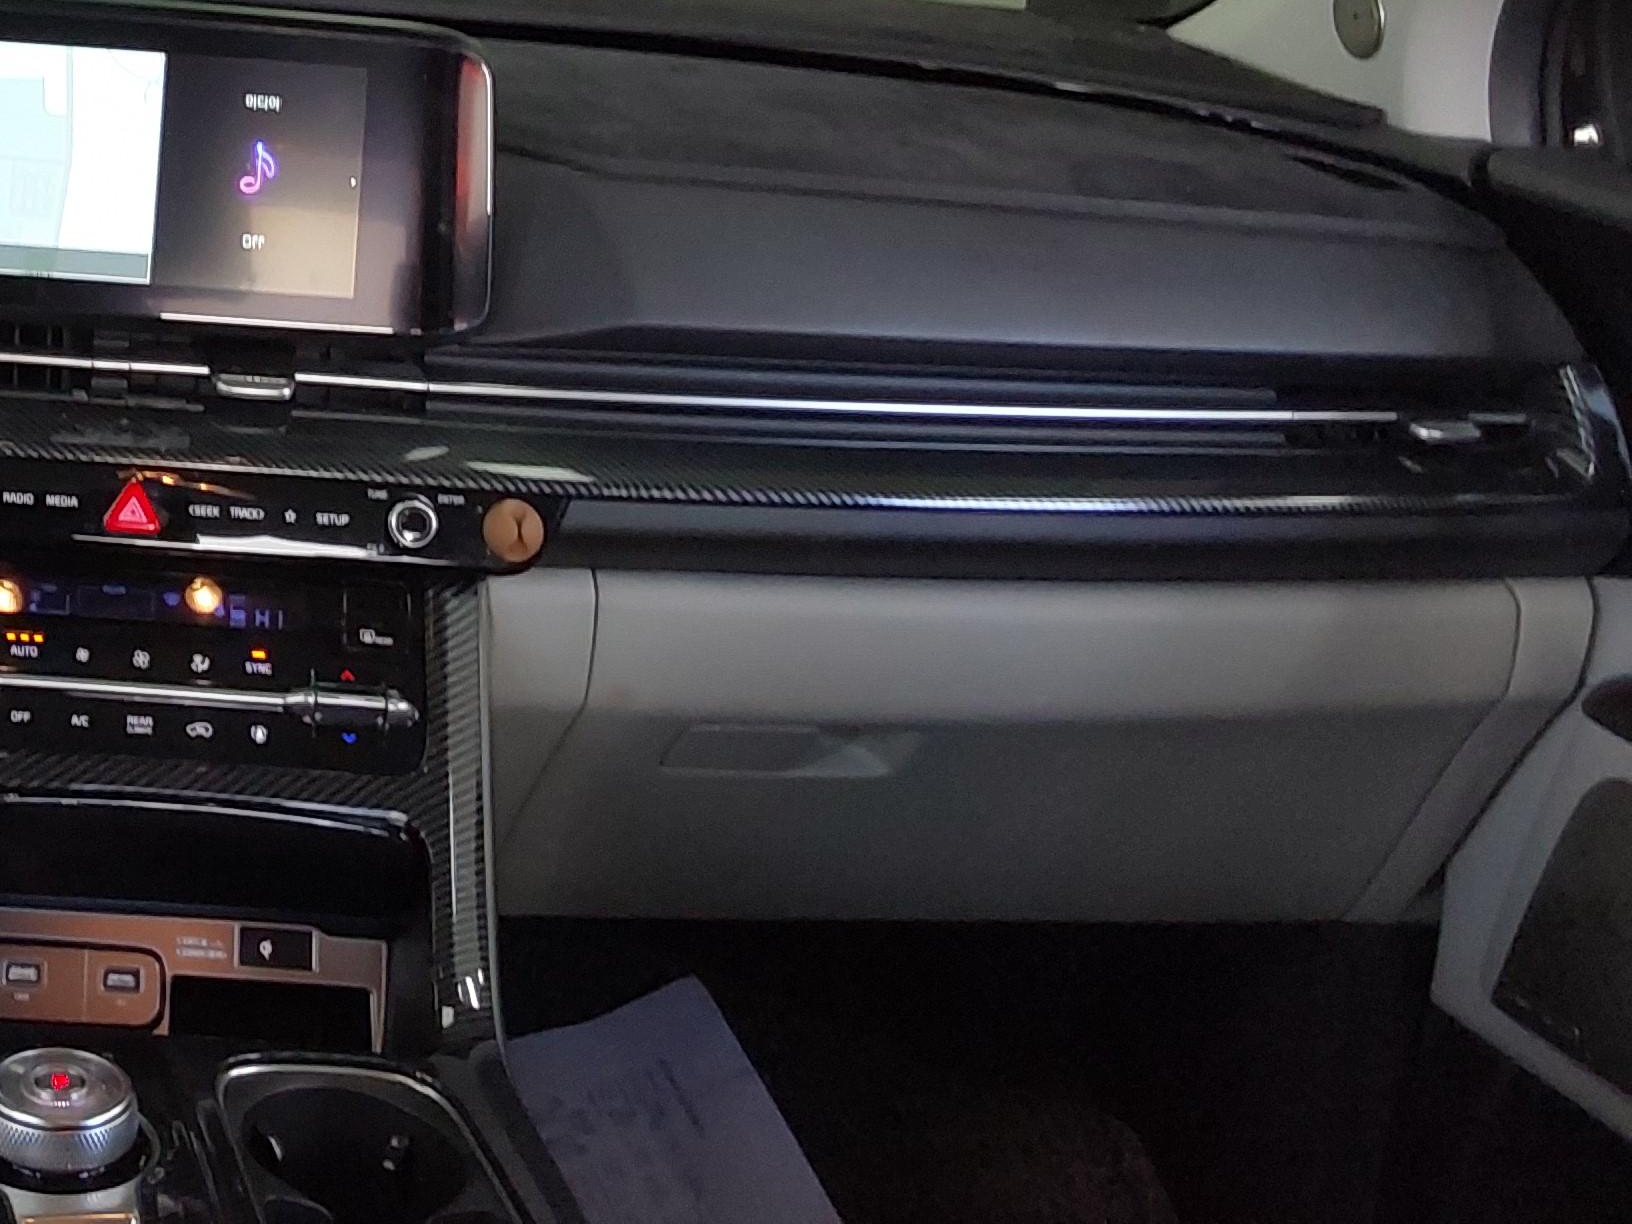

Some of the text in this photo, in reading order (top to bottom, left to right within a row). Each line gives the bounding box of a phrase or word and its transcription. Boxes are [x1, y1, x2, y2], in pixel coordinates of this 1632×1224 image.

[2, 491, 34, 505] RADIO
[45, 494, 79, 508] MEDIA
[316, 512, 350, 526] SETUP
[10, 644, 39, 658] AUTO
[245, 661, 272, 675] SYNC
[10, 710, 32, 723] OFF
[71, 714, 89, 727] A/C
